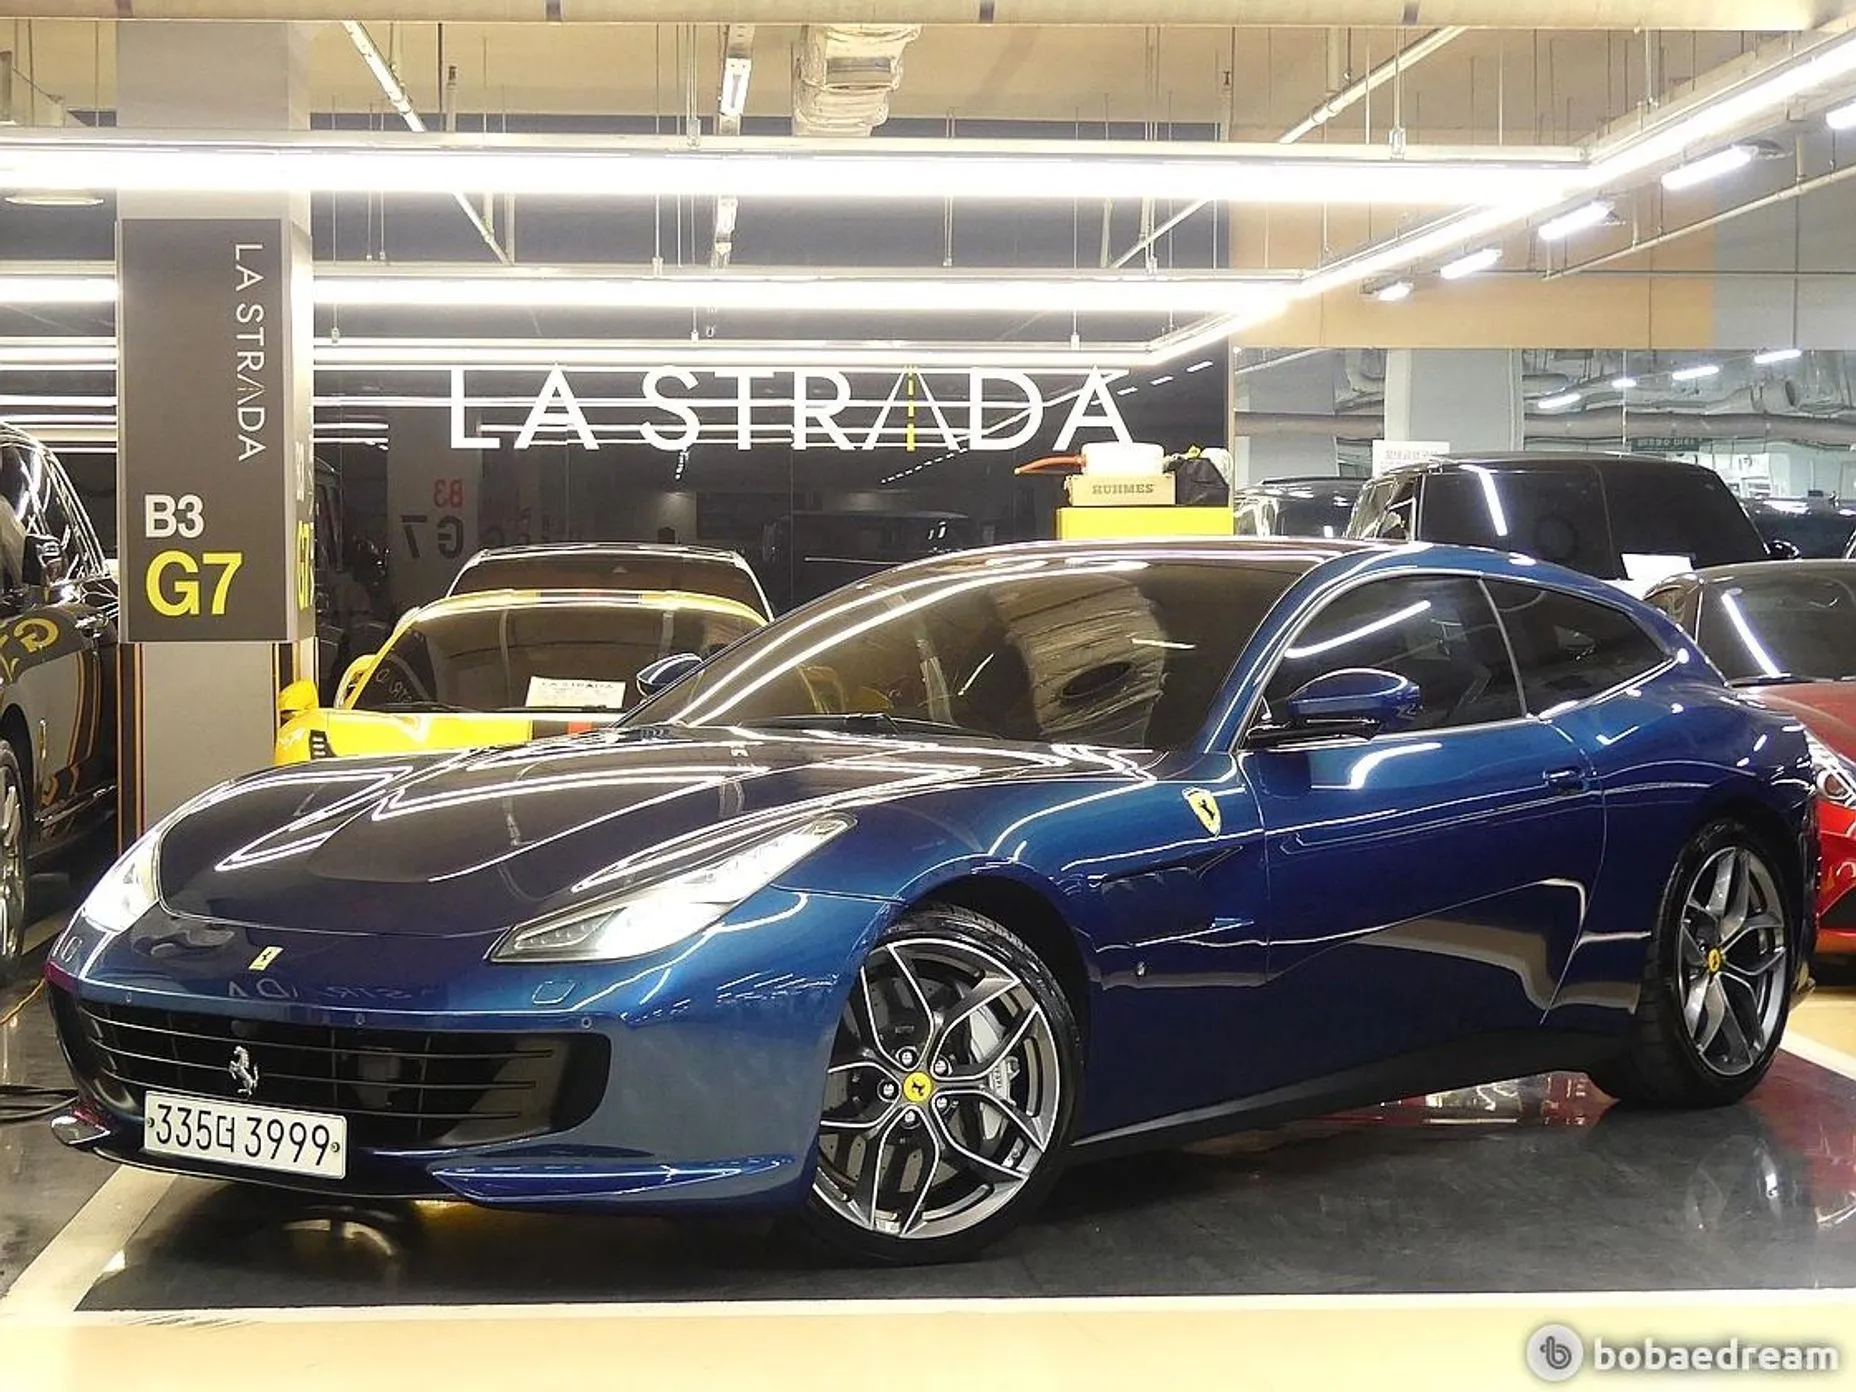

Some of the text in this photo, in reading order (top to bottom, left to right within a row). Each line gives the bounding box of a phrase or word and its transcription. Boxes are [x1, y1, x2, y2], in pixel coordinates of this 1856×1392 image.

[235, 243, 267, 462] LA STRADA
[450, 363, 1134, 451] LA STRADA
[144, 494, 204, 538] B3
[145, 551, 243, 617] G7
[244, 1116, 331, 1166] 3999
